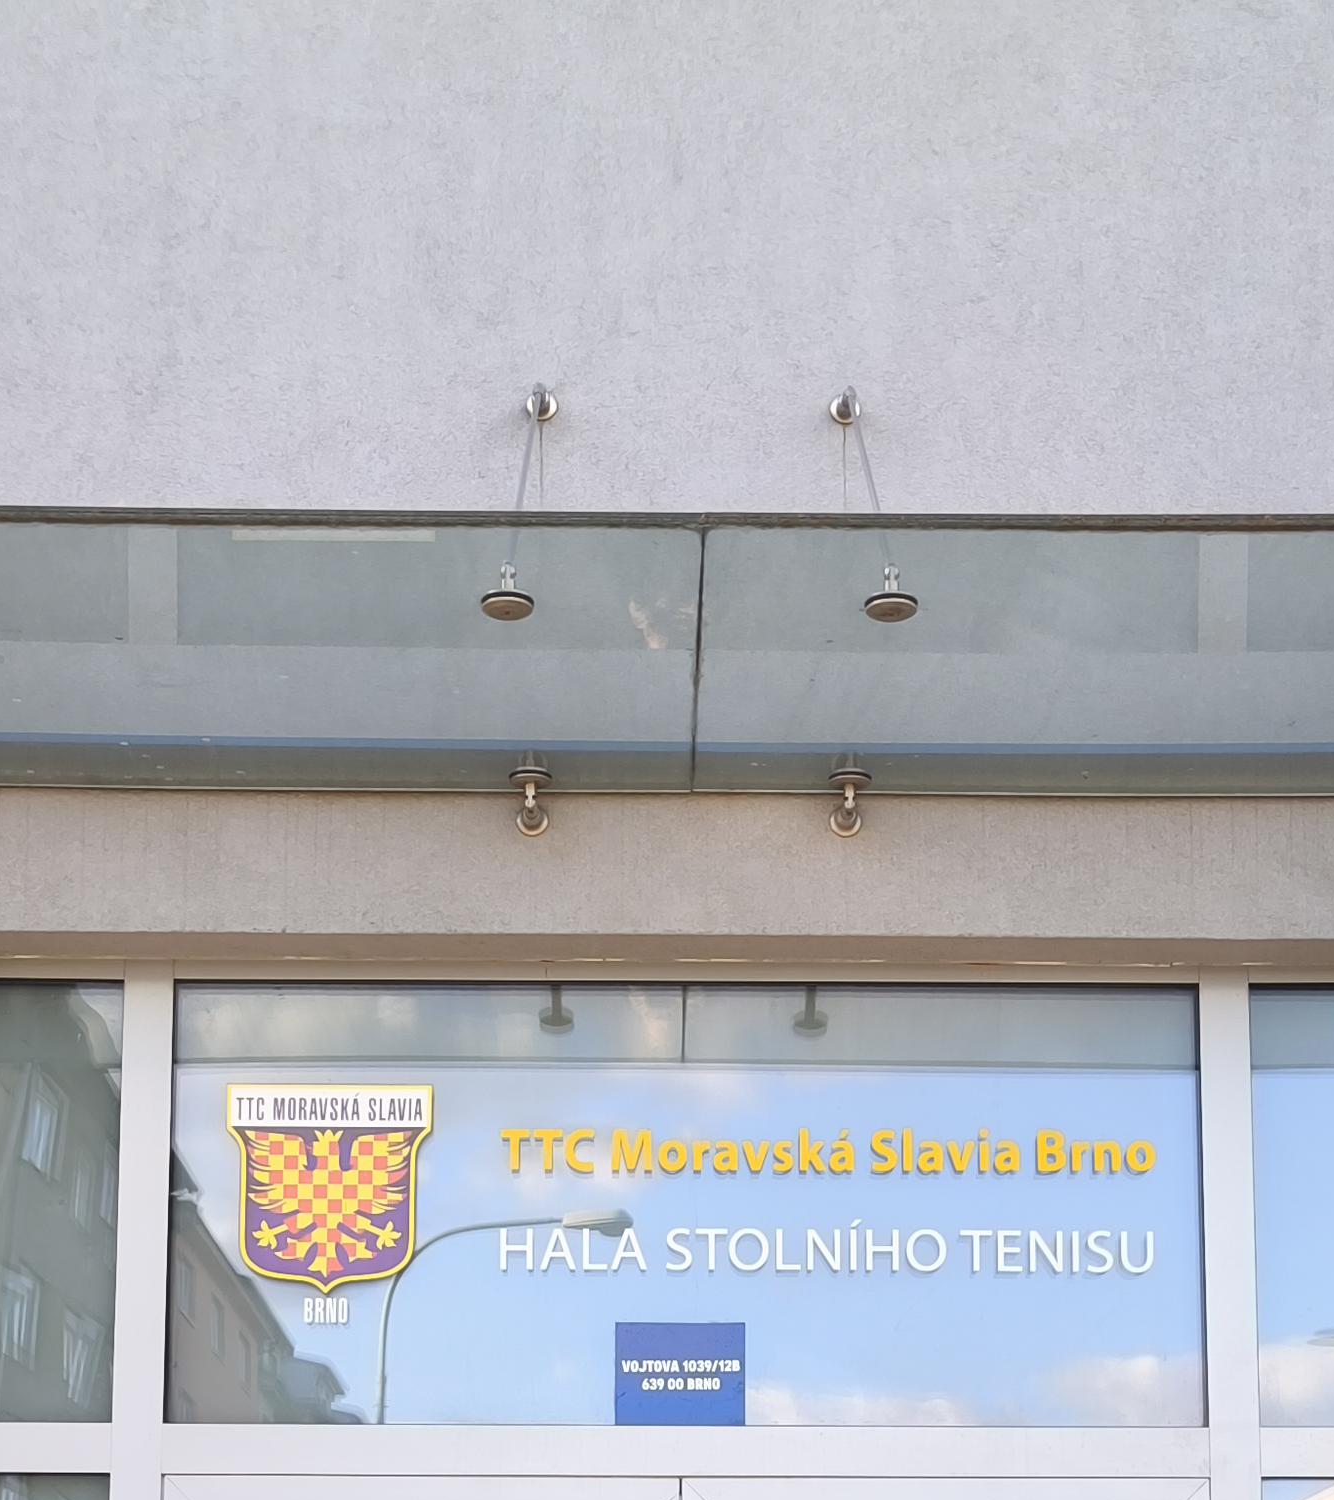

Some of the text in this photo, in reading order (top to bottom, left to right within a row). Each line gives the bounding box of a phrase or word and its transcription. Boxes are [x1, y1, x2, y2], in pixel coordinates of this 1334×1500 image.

[236, 1092, 423, 1122] TTC MORAVSKÁ SLAVIA
[500, 1127, 1157, 1174] TTC Moravská Slavia Brno
[498, 1218, 1156, 1274] HALA STOLNÍHO TENISU
[303, 1297, 349, 1324] BRNO
[621, 1359, 741, 1373] VOJTOVA 1039/12B
[641, 1377, 721, 1391] 639 00 BRNO
